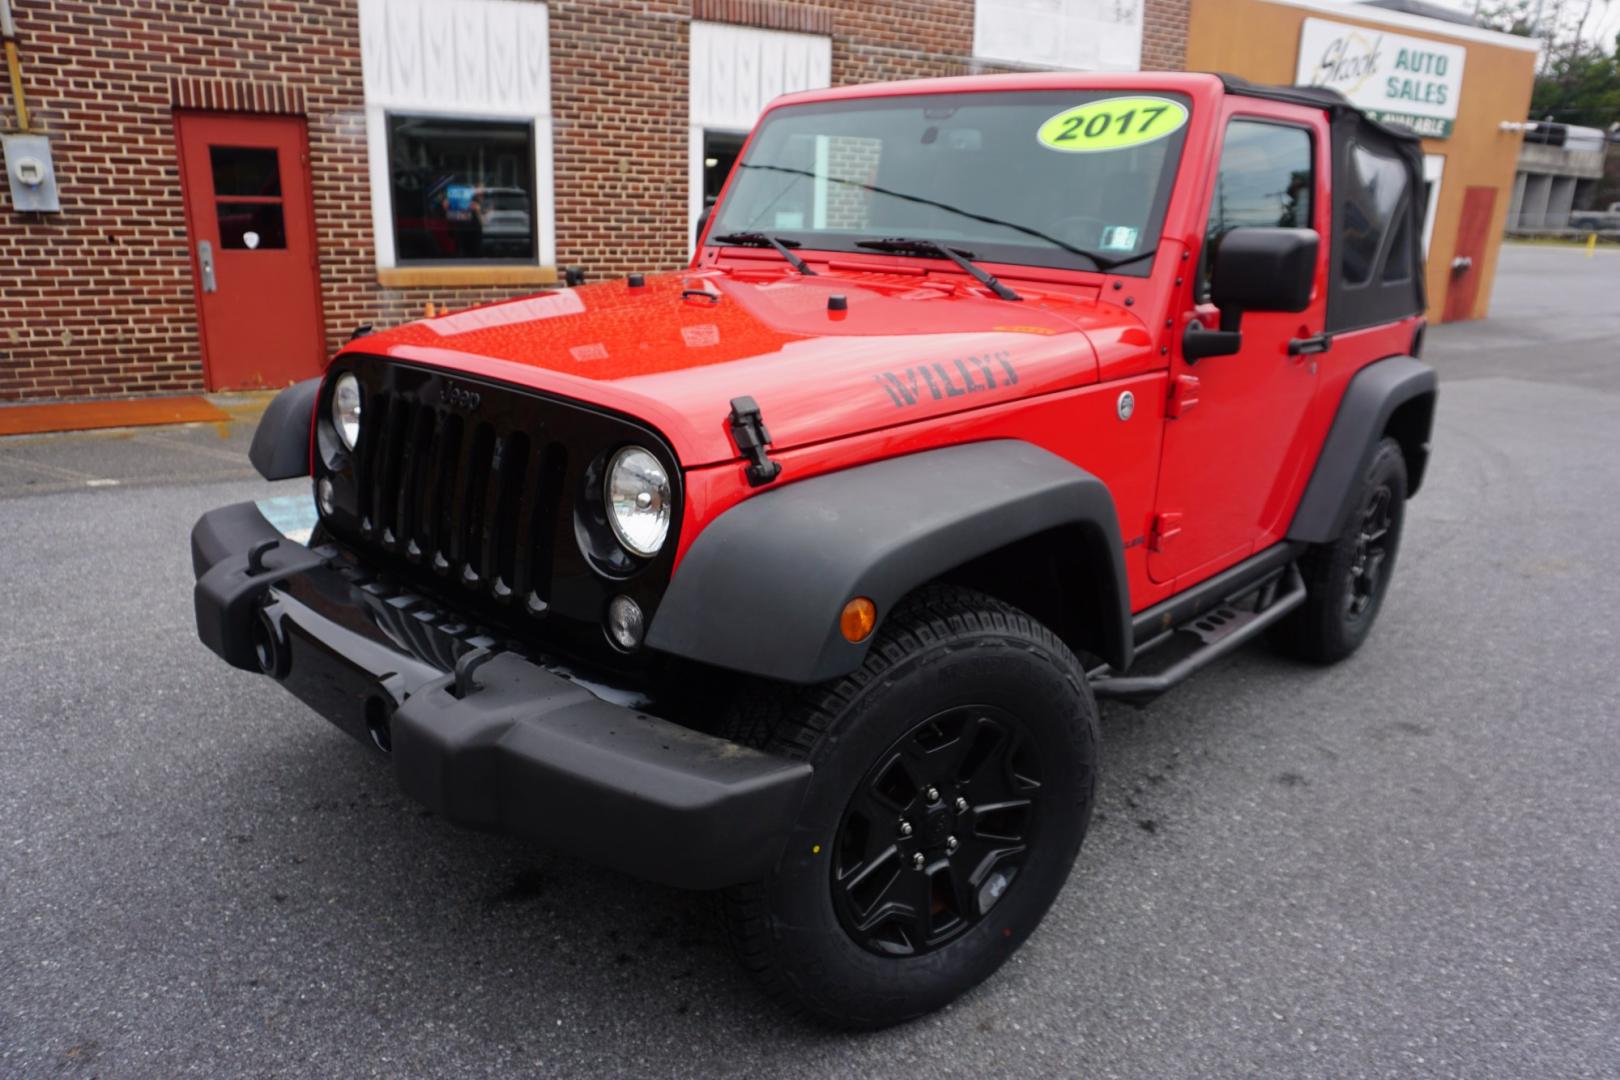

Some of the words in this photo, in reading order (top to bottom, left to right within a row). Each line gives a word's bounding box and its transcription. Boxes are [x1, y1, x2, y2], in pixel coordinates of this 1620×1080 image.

[1395, 48, 1449, 77] AUTO
[1385, 76, 1448, 105] SALES
[1053, 105, 1169, 142] 2017
[873, 351, 1019, 408] WILLYS
